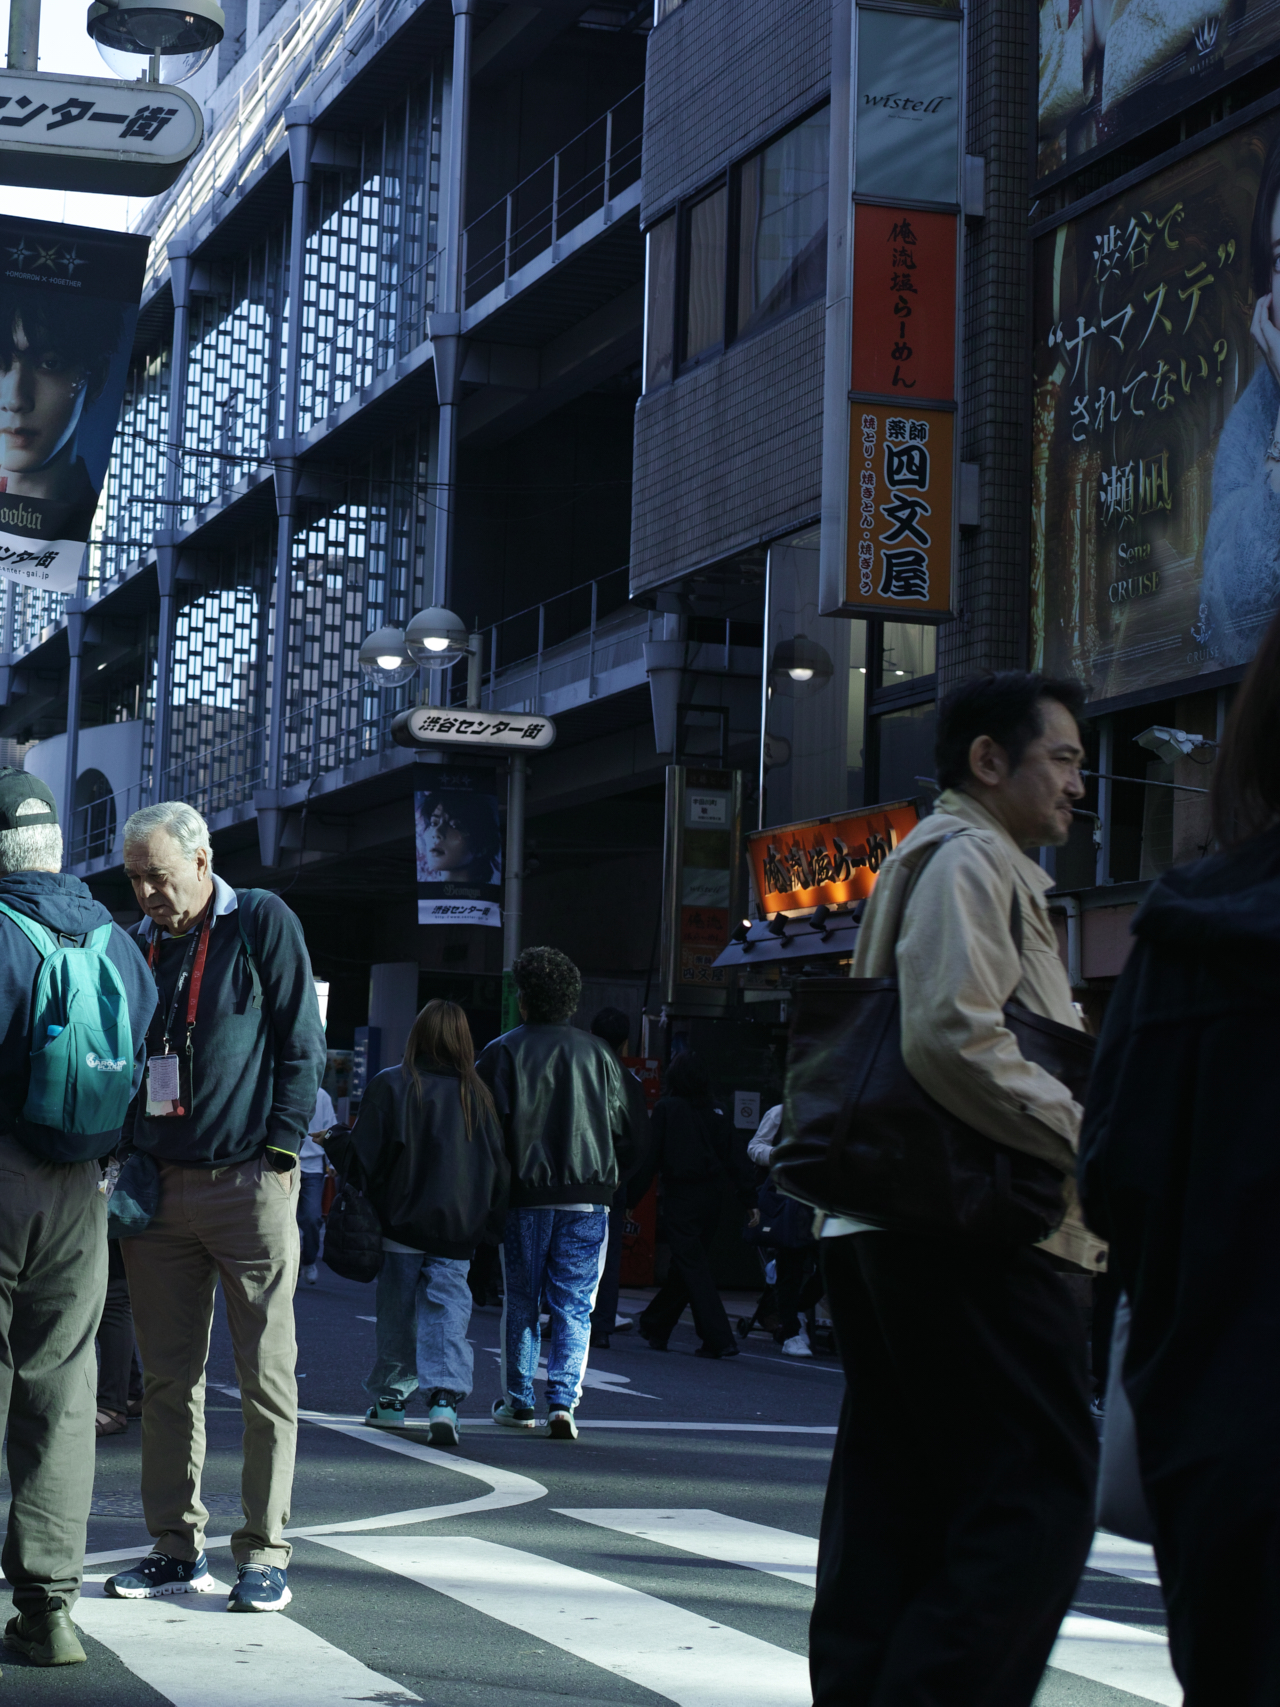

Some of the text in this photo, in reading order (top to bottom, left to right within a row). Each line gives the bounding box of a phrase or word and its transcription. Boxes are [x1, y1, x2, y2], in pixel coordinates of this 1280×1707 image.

[863, 92, 952, 114] wistell
[1093, 201, 1185, 284] 渋谷で
[885, 217, 919, 389] 俺流塩らーめん
[885, 419, 929, 441] 薬師
[880, 441, 932, 601] 四文屋
[1117, 541, 1151, 568] Sena
[1108, 571, 1162, 604] CRUISE
[418, 716, 545, 740] 渋谷センター街
[431, 905, 491, 916] 渋谷センター街
[683, 967, 724, 982] 四文屋
